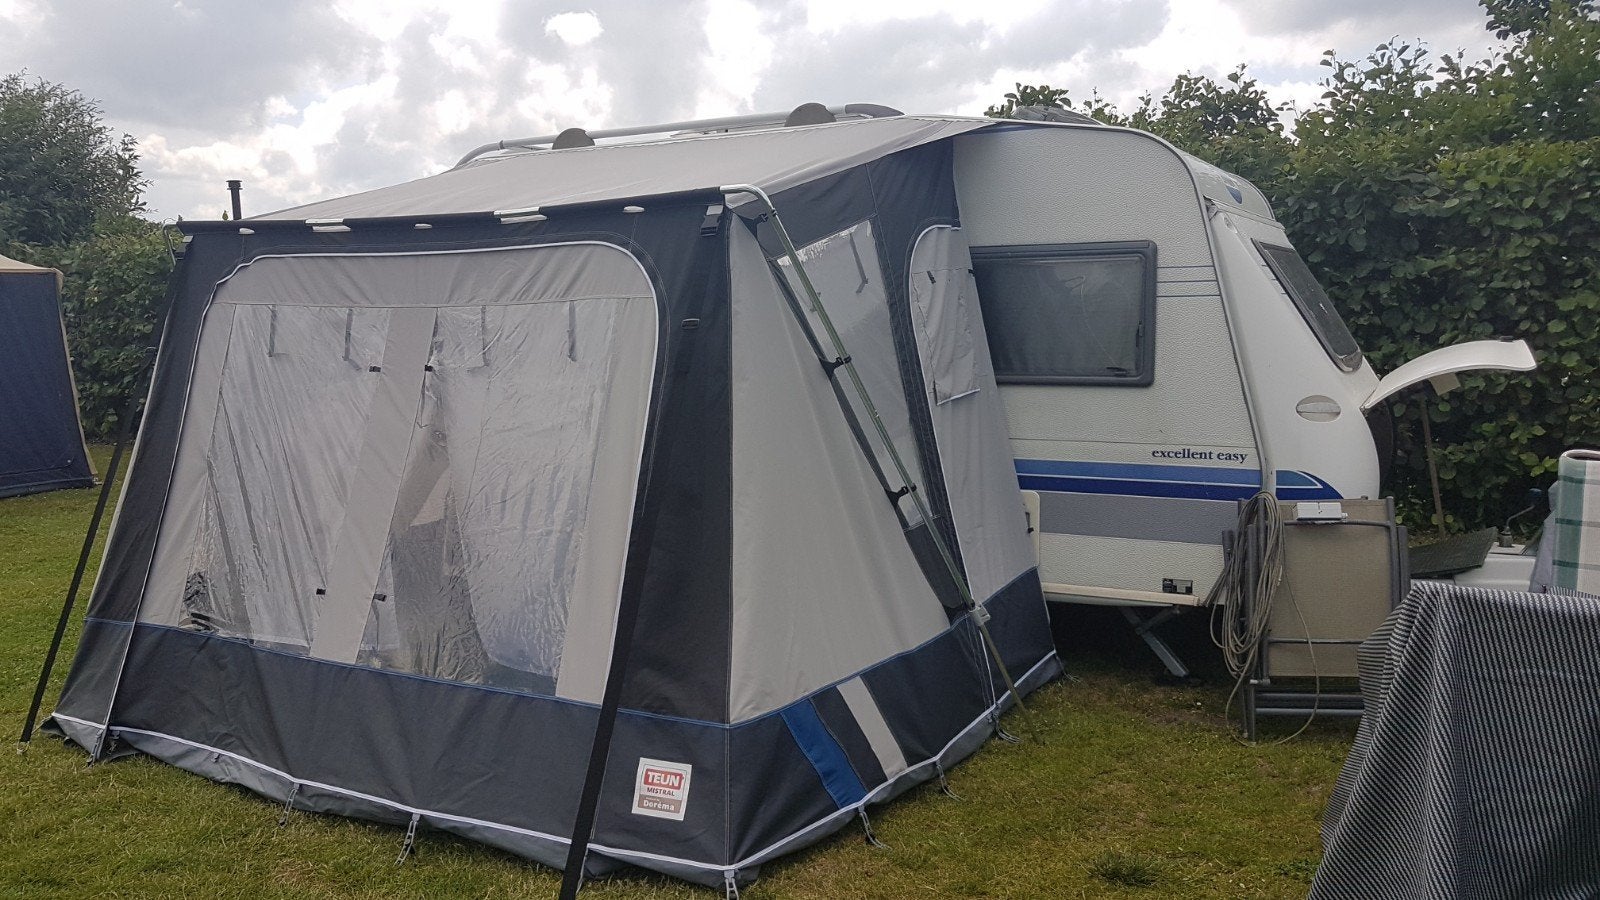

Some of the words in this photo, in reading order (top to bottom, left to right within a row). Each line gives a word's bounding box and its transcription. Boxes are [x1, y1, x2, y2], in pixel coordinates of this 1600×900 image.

[1152, 448, 1213, 460] excellent
[1216, 451, 1248, 463] easy
[647, 771, 680, 786] TEUN
[647, 787, 675, 796] MISTRAL
